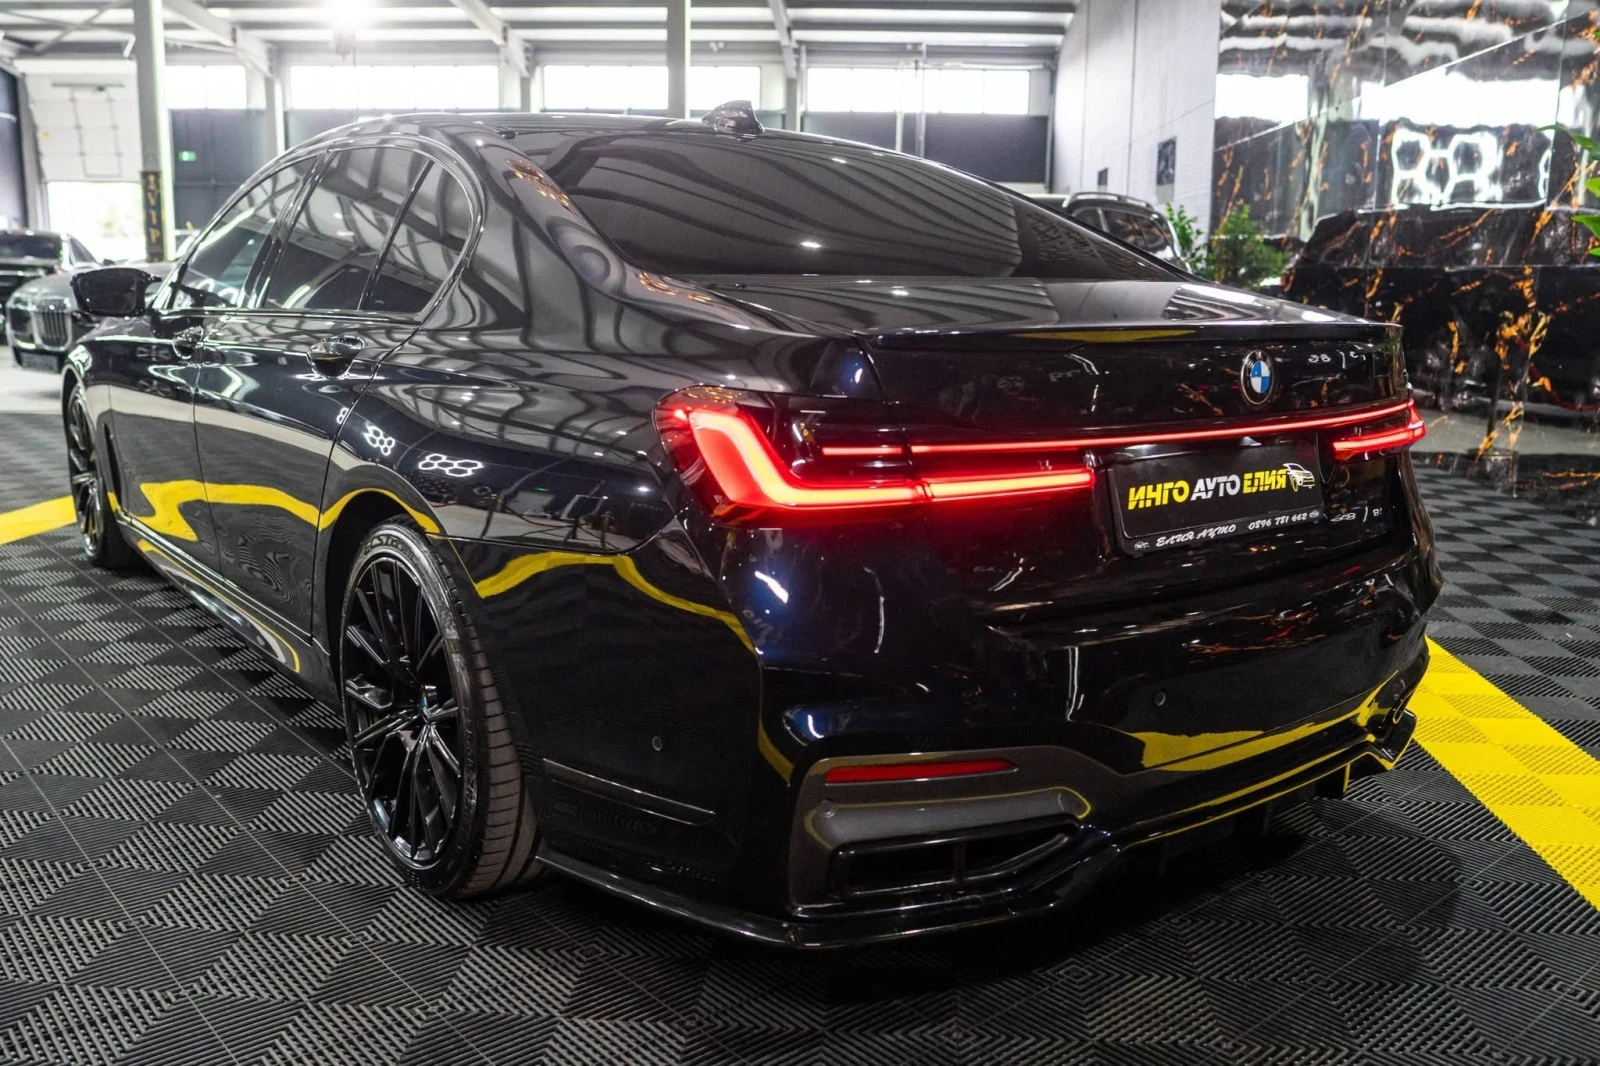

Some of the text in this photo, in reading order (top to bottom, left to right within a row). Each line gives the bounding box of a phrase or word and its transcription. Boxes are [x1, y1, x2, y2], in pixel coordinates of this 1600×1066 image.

[1127, 468, 1288, 510] ИНГО АУТО ЕЛИЯ
[1248, 518, 1272, 531] 0896
[1274, 515, 1290, 526] 781
[1291, 512, 1308, 522] 662
